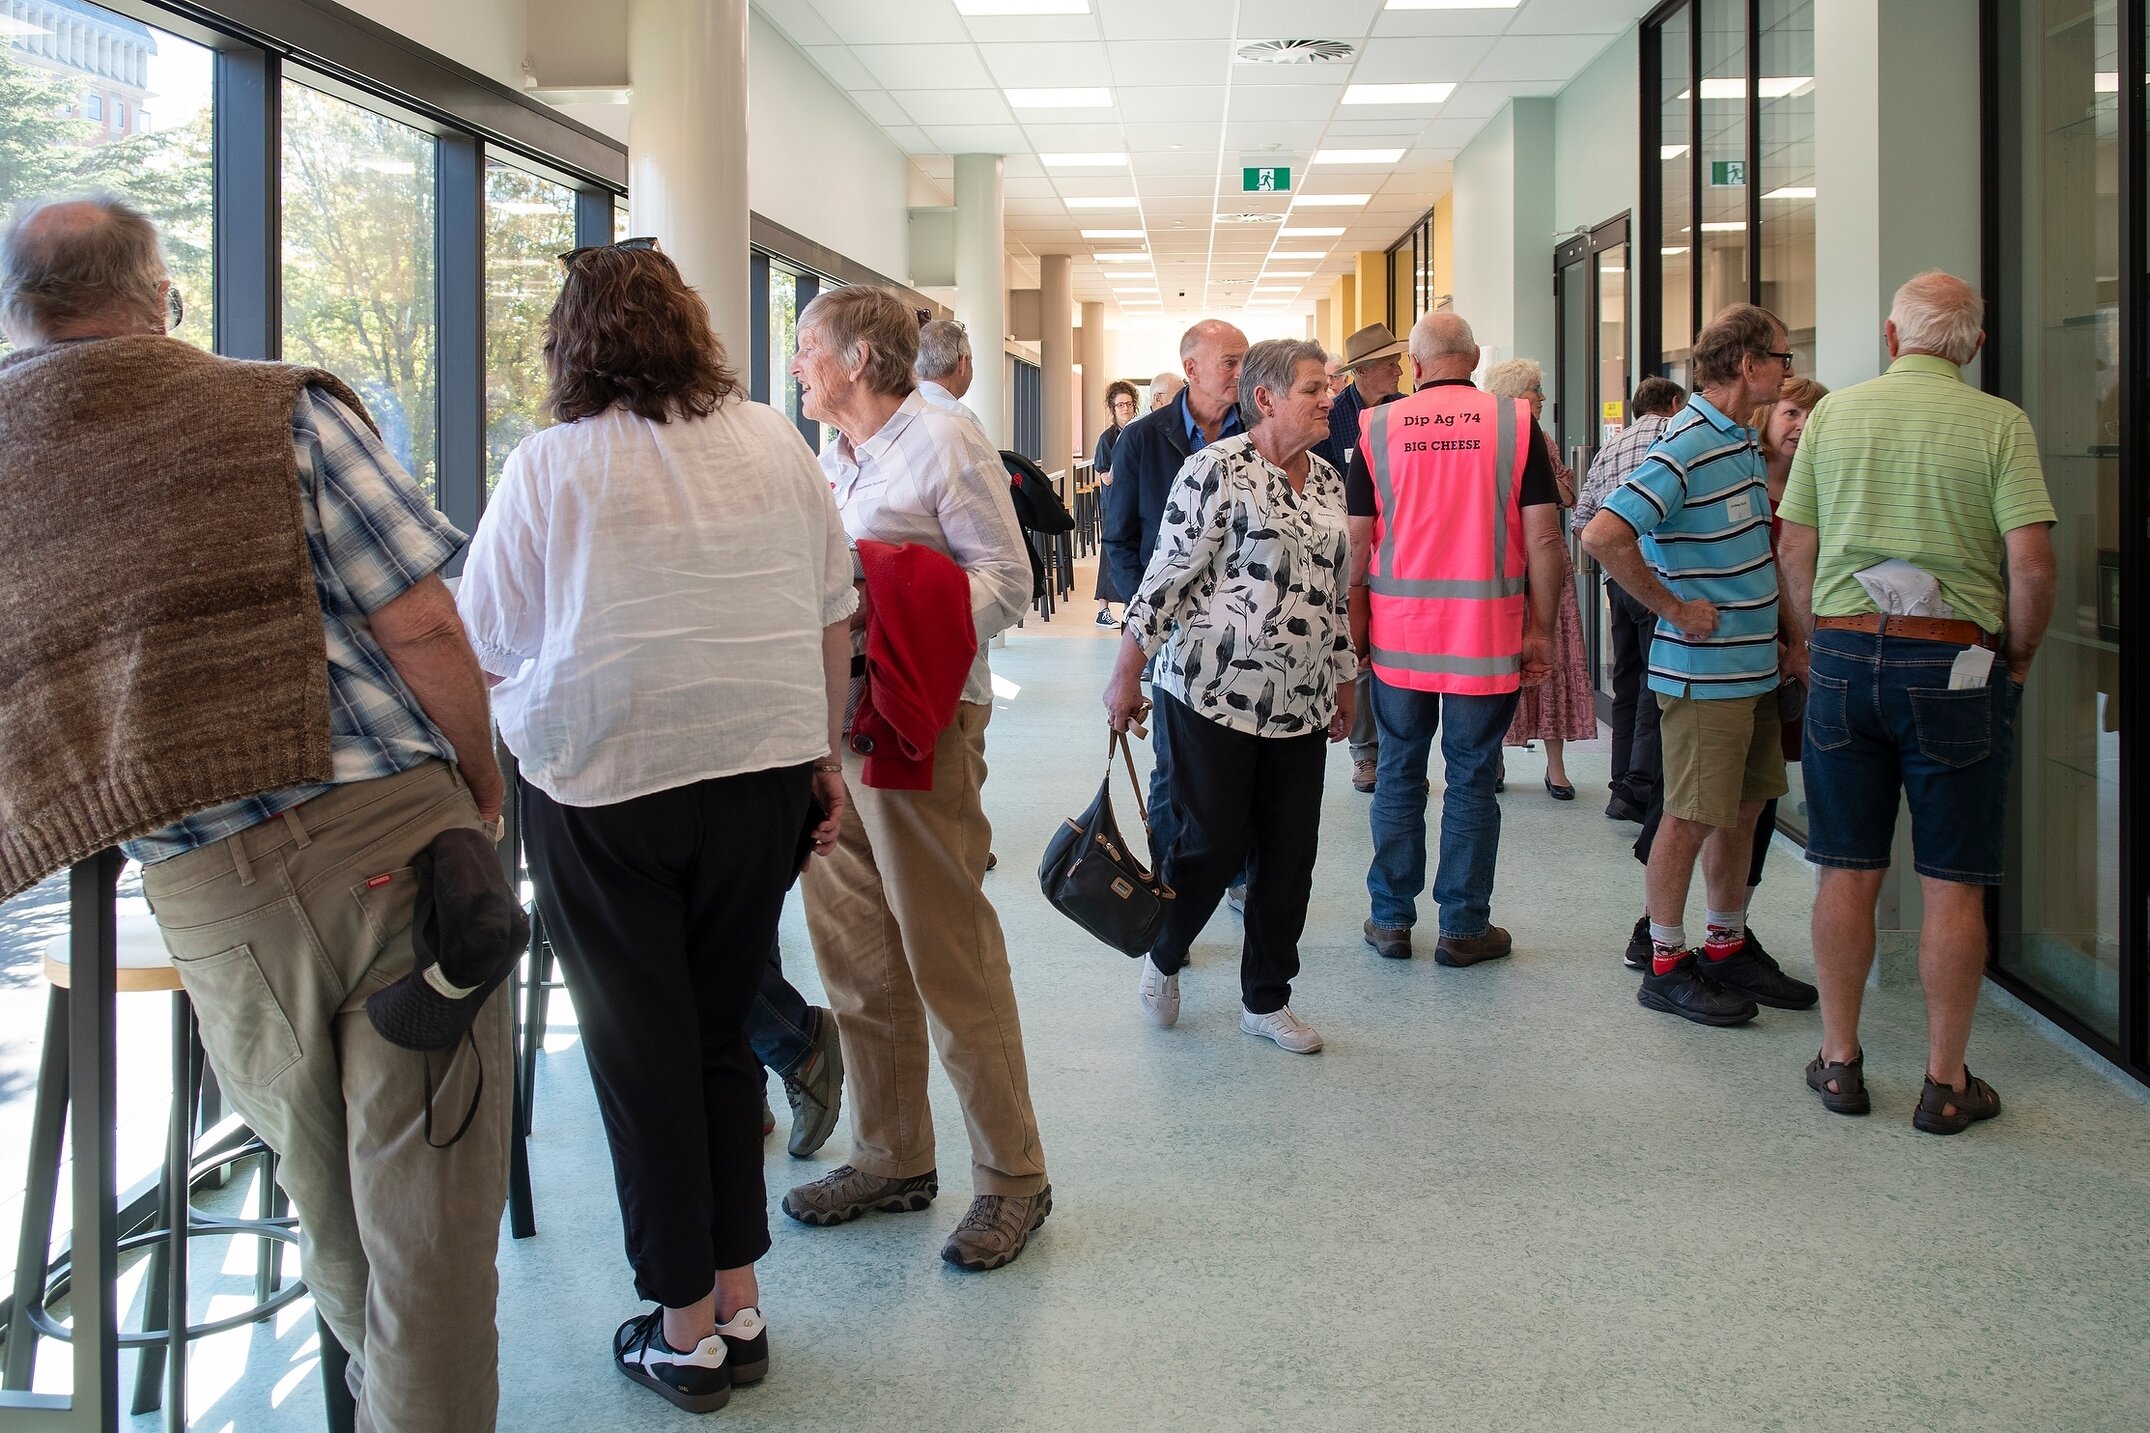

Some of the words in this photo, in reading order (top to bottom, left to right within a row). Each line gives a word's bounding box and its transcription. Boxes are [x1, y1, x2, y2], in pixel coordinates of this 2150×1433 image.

[1404, 416, 1430, 427] Dip
[1434, 414, 1455, 427] Ag
[1459, 413, 1481, 423] ‘74
[1404, 441, 1427, 452] BIG
[1431, 440, 1481, 451] CHEESE
